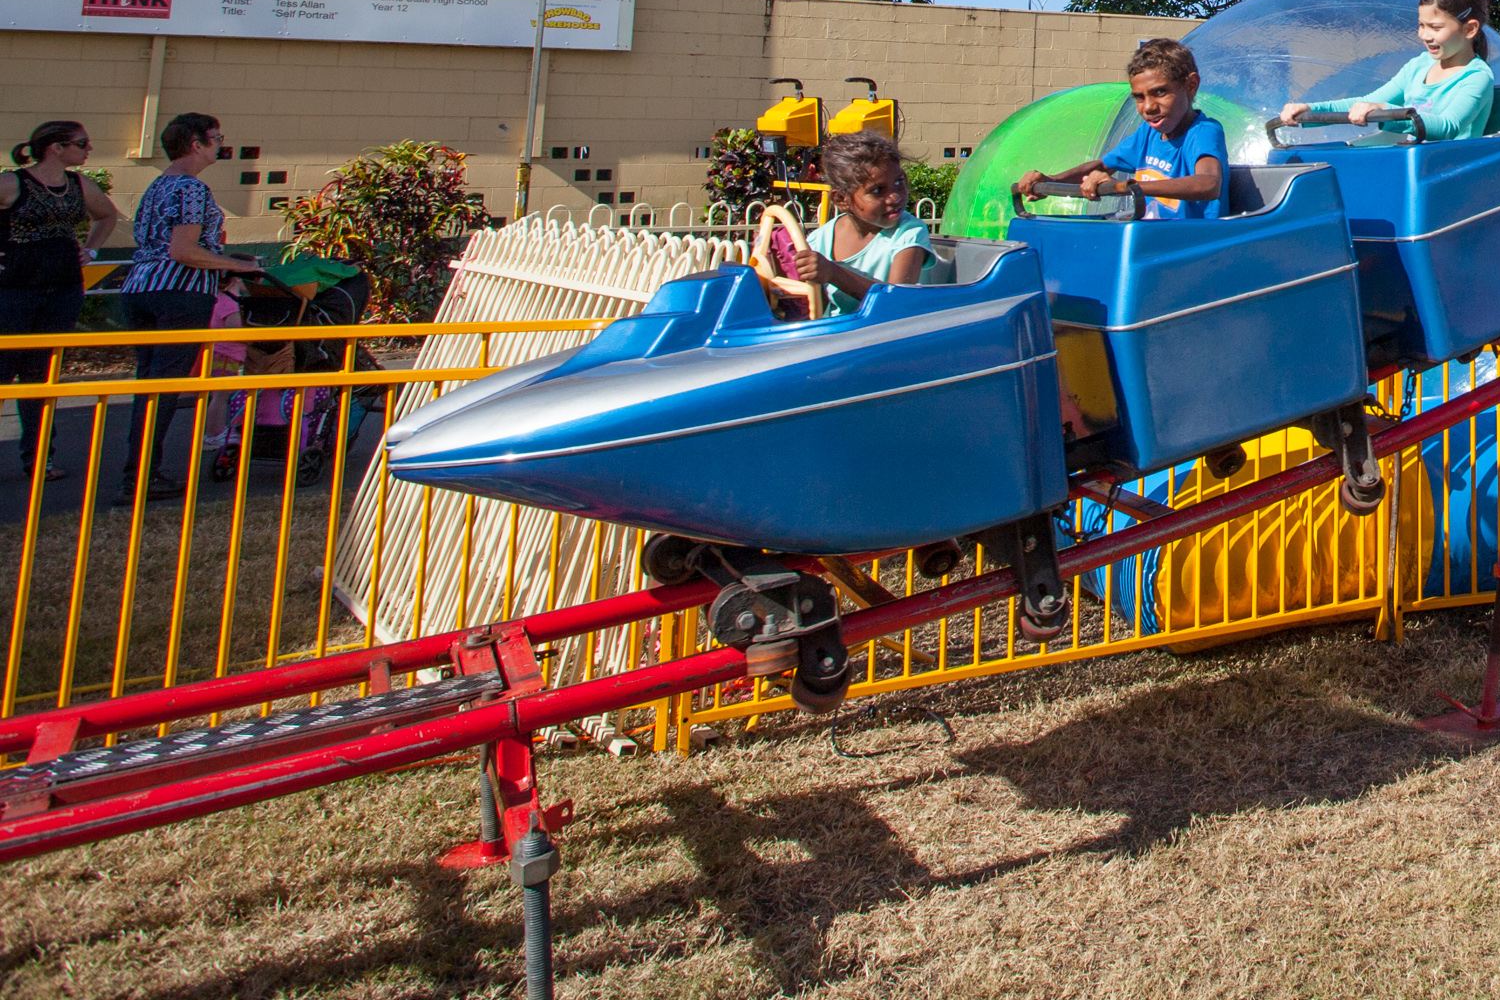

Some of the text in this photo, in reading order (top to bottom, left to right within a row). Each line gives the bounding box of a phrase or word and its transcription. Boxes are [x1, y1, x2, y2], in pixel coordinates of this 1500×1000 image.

[300, 0, 326, 9] Allan
[372, 2, 409, 12] Year 12
[221, 6, 339, 20] Title: "Self Portrait"
